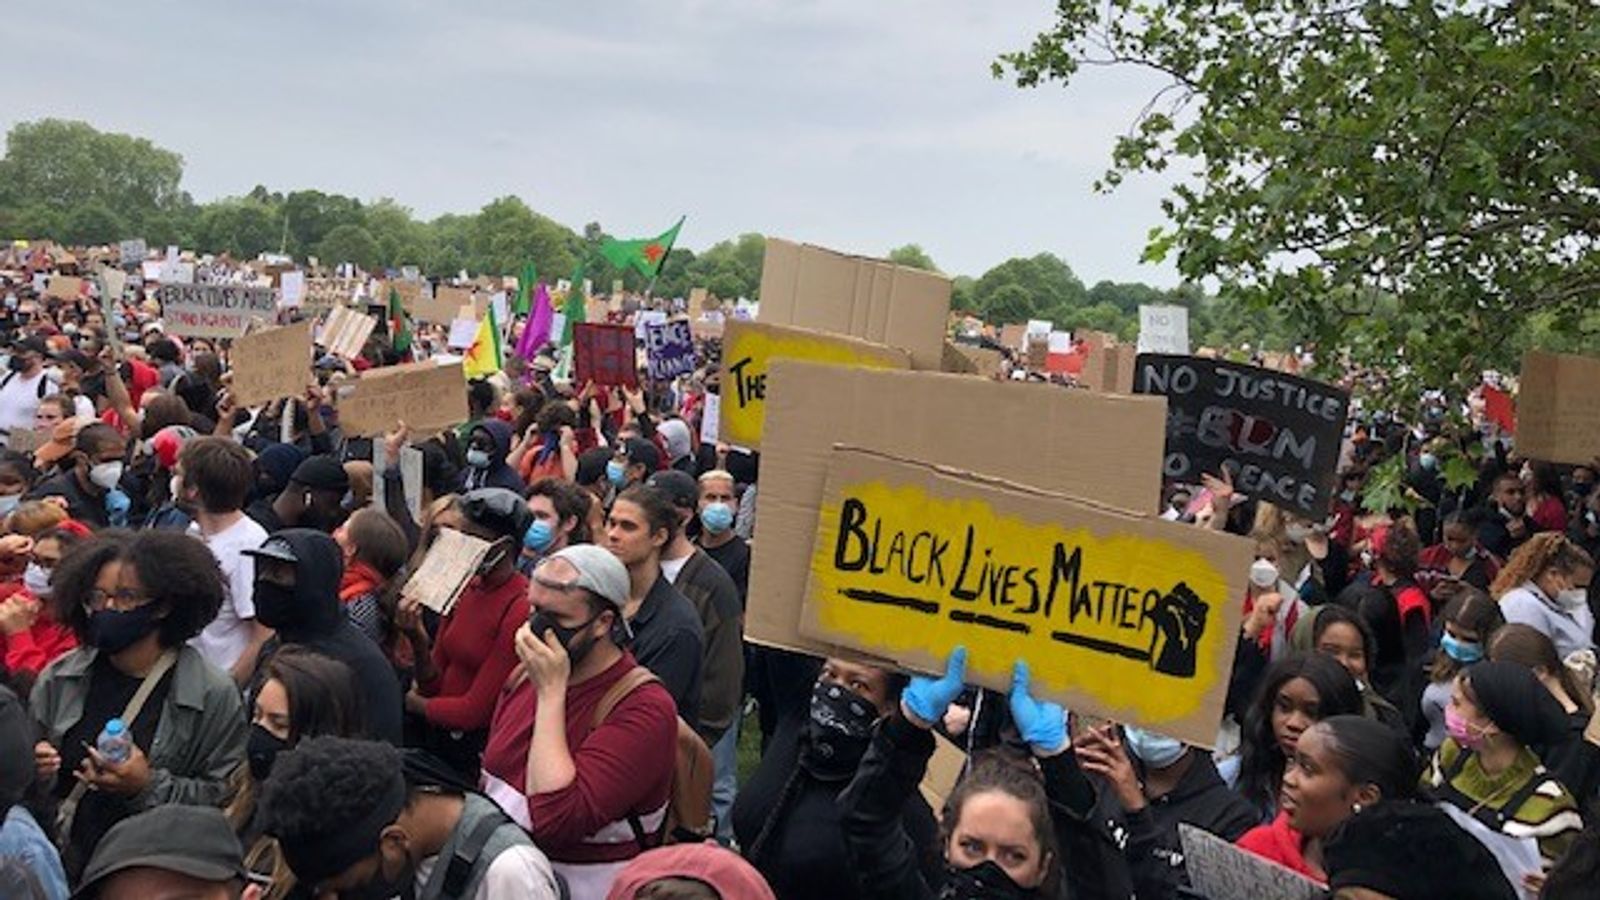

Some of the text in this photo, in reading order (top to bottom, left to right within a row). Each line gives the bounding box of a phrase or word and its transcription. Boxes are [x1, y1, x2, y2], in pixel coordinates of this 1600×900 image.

[165, 285, 202, 305] BLACK
[206, 287, 239, 308] LIVES
[730, 356, 767, 409] THE
[1144, 364, 1341, 422] NO JUSTICE
[1165, 452, 1190, 477] O
[834, 497, 949, 588] BLACK
[1044, 541, 1161, 655] MATTER
